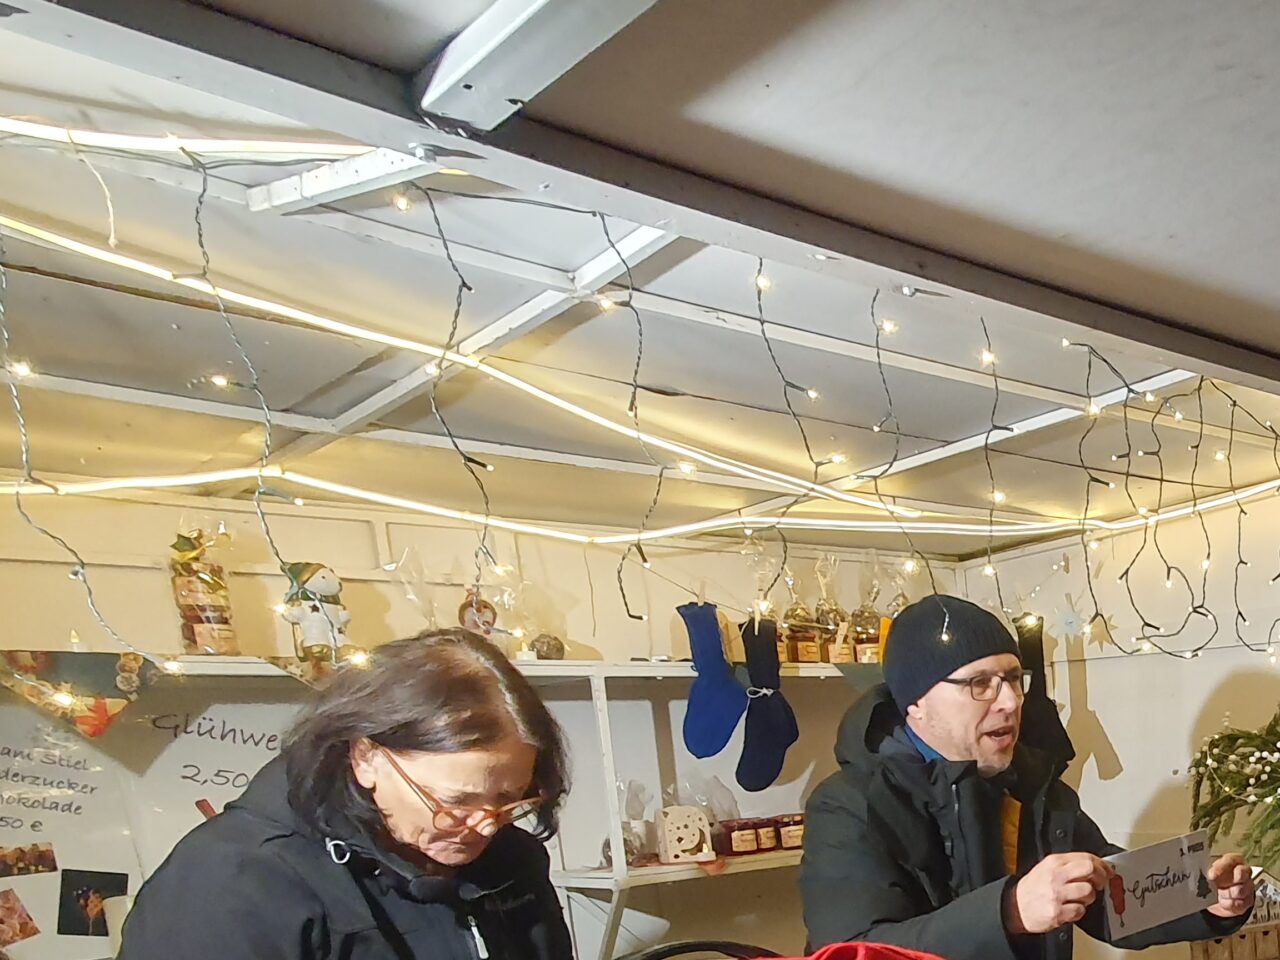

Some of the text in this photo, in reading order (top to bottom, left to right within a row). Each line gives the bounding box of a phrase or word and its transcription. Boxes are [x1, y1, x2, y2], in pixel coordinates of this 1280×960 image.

[152, 713, 279, 751] Glühwe
[40, 753, 89, 771] Stiel
[181, 764, 249, 789] 2,50
[30, 820, 43, 832] €
[1126, 865, 1191, 908] Gutschein
